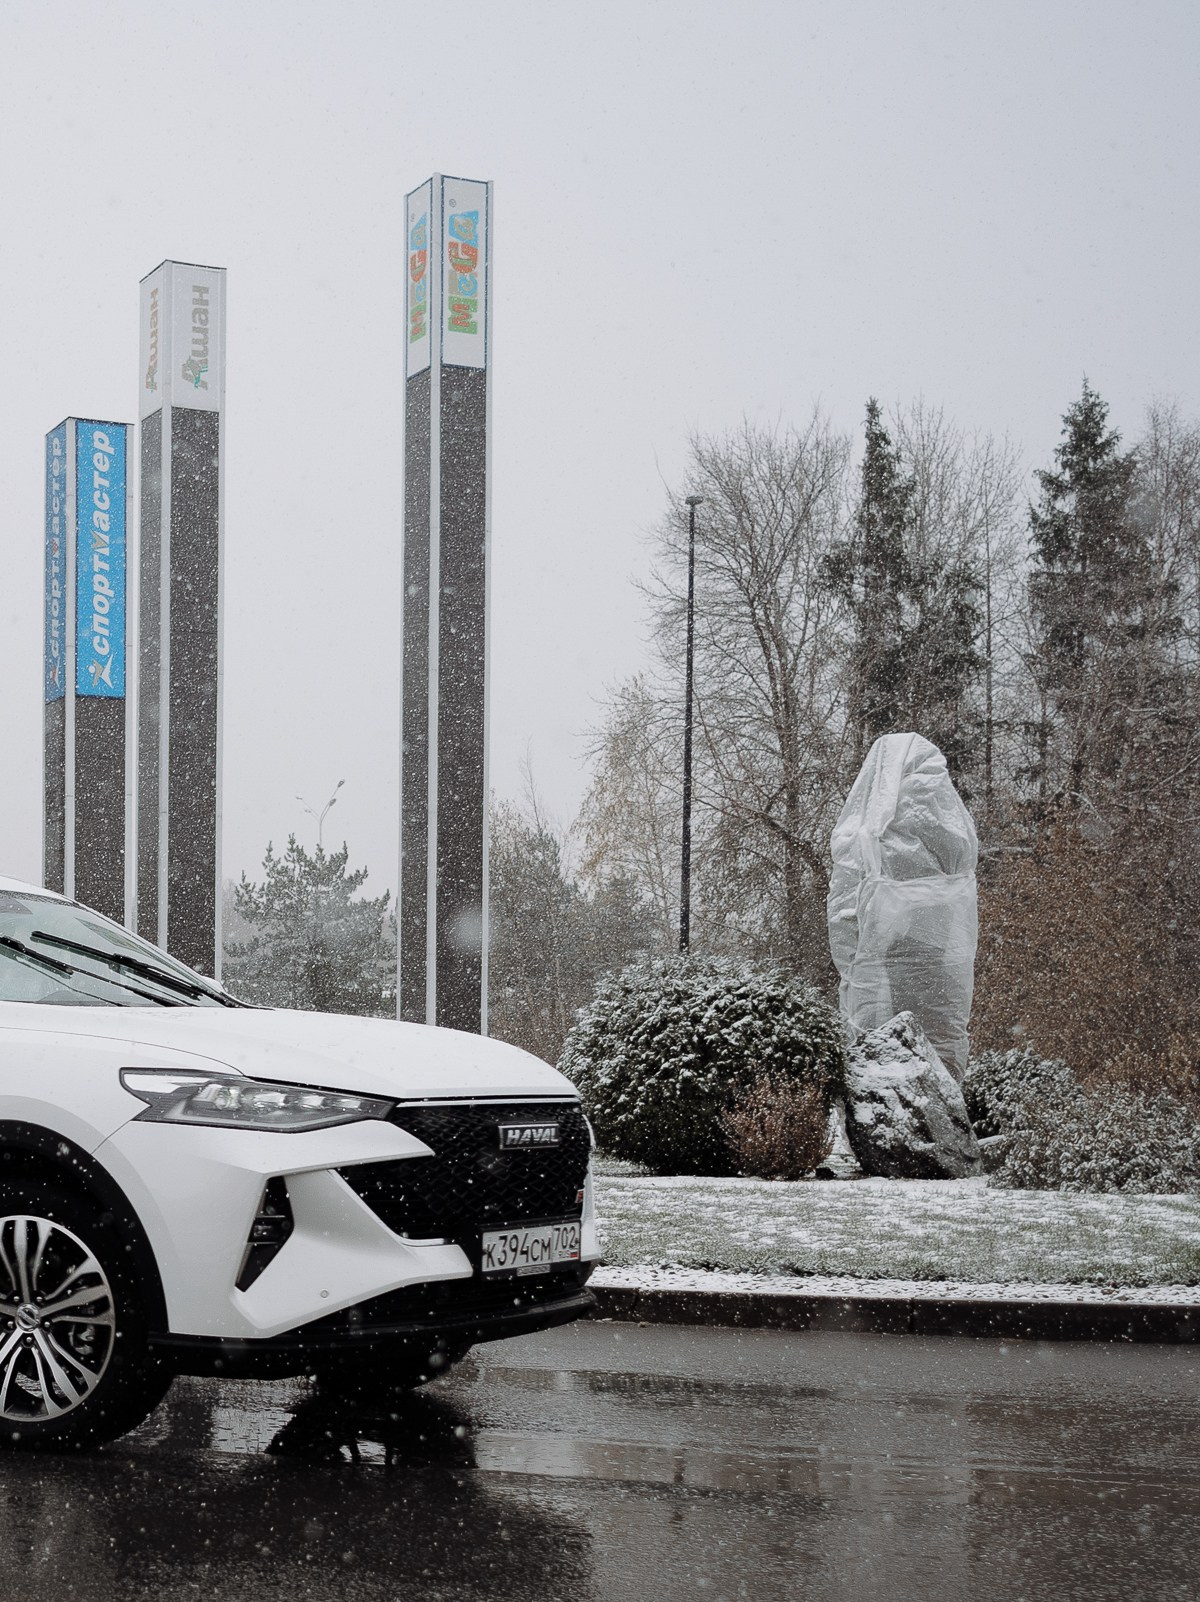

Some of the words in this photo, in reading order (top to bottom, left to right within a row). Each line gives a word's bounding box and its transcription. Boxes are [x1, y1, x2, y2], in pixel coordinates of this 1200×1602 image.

[91, 430, 116, 656] спортмастер
[505, 1127, 560, 1146] HAVAL
[553, 1225, 577, 1251] 702
